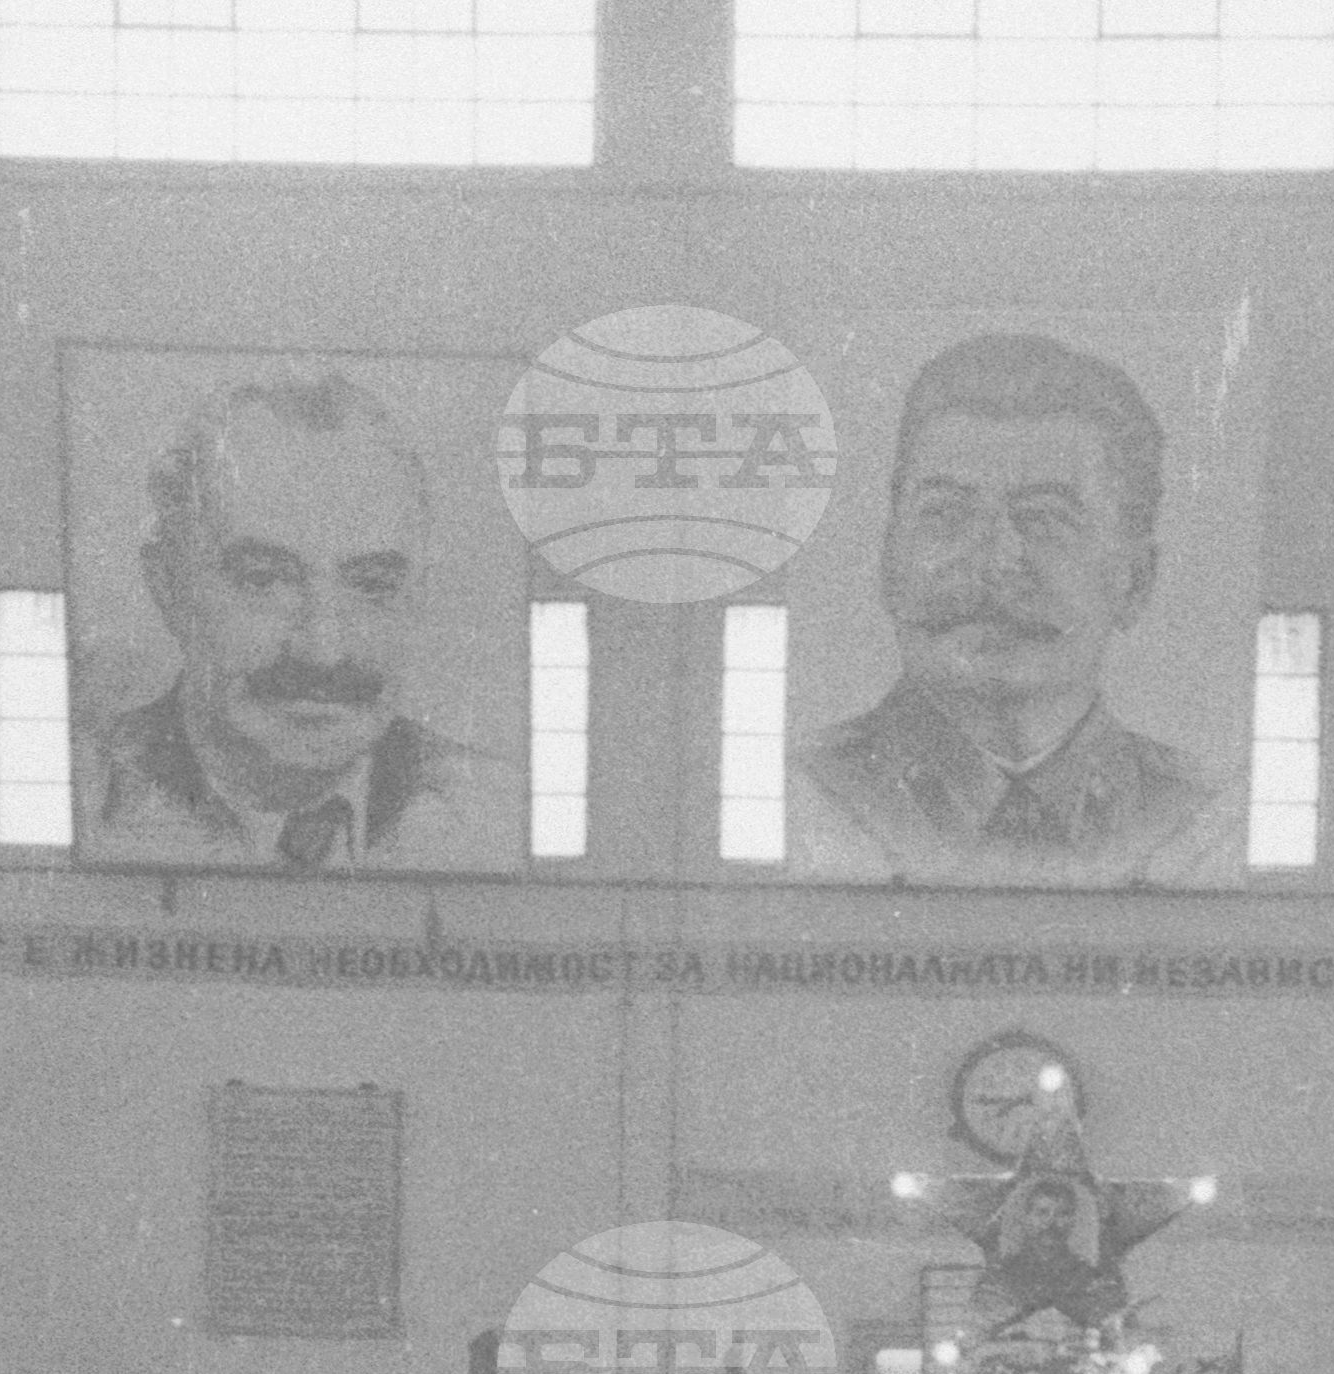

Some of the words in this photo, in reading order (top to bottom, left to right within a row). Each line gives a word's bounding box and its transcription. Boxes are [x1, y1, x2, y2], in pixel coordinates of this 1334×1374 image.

[23, 934, 46, 966] Е
[71, 935, 286, 975] ЖИЗНЕНА
[307, 945, 638, 985] НЕОБХОДИМОСТ
[654, 950, 706, 985] ЗА
[726, 952, 1050, 987] НАЦИОНАЛНАТА
[1064, 954, 1119, 985] НИ
